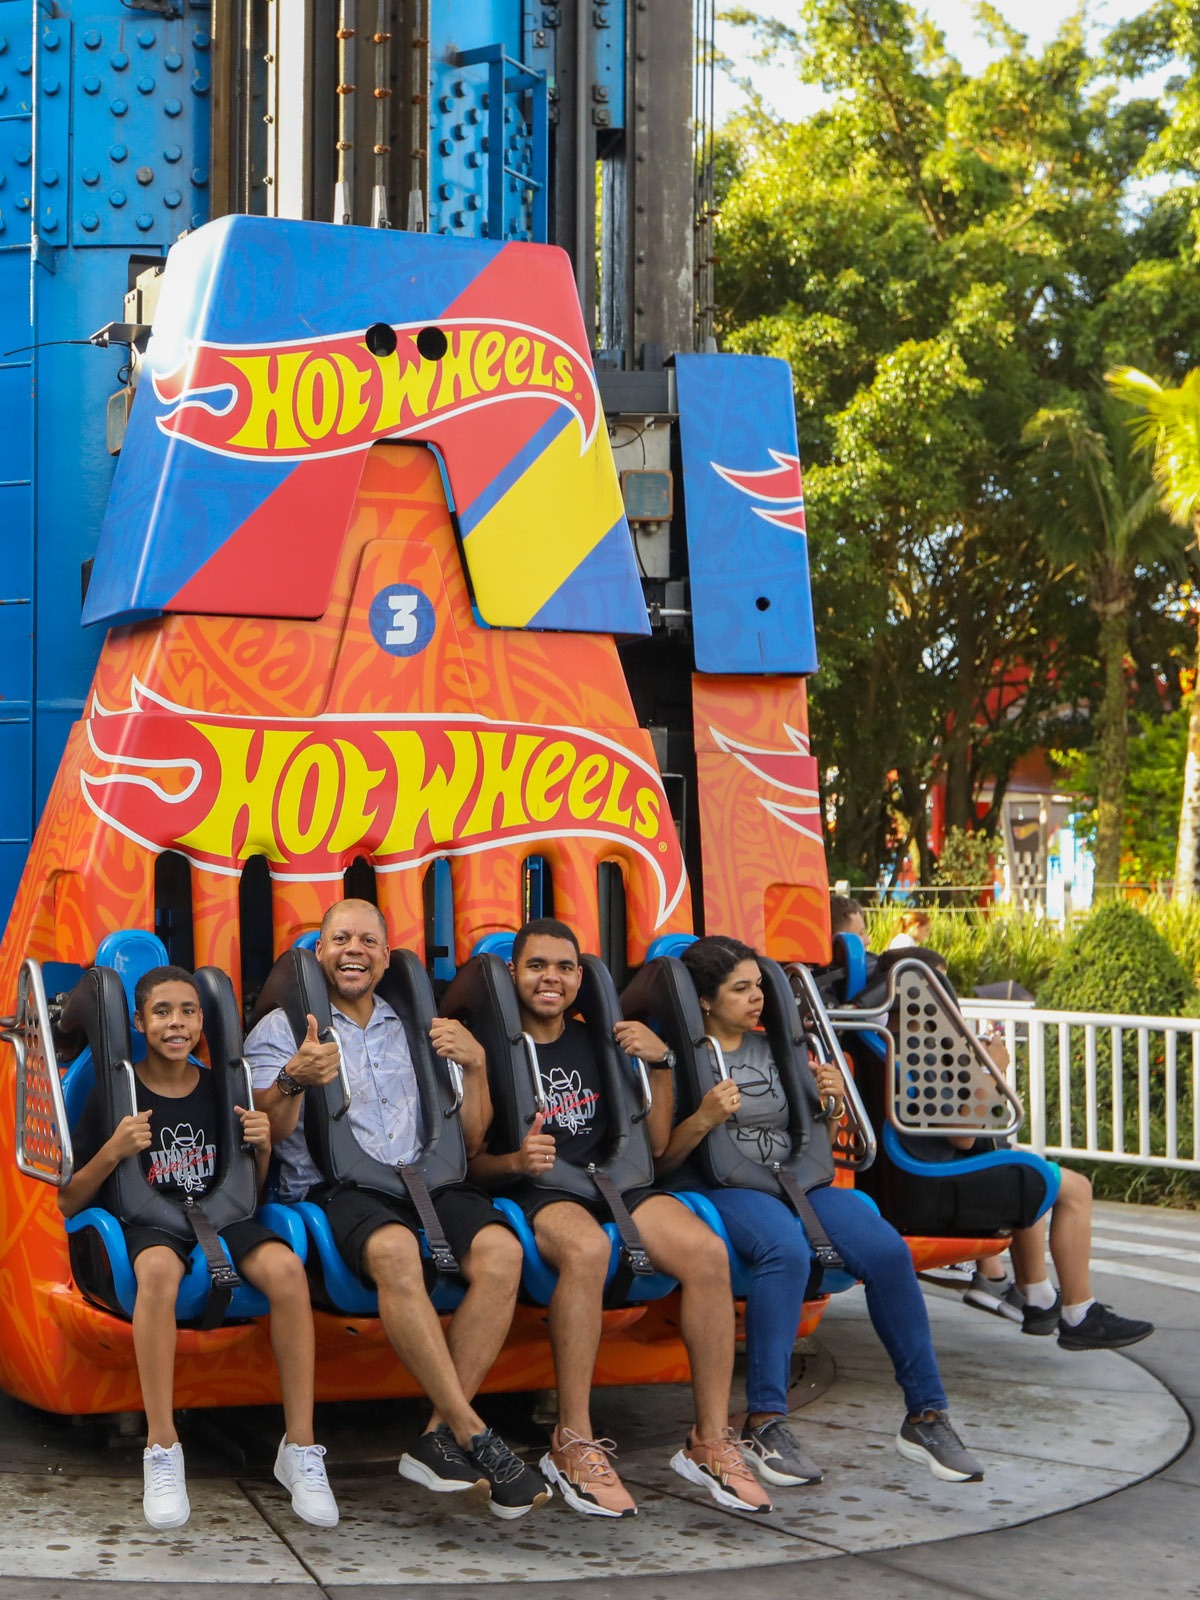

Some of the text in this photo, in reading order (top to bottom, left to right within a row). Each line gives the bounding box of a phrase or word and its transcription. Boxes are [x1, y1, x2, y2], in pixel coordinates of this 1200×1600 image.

[219, 350, 373, 450] HOT
[385, 594, 418, 645] 3
[173, 719, 388, 864] HOT
